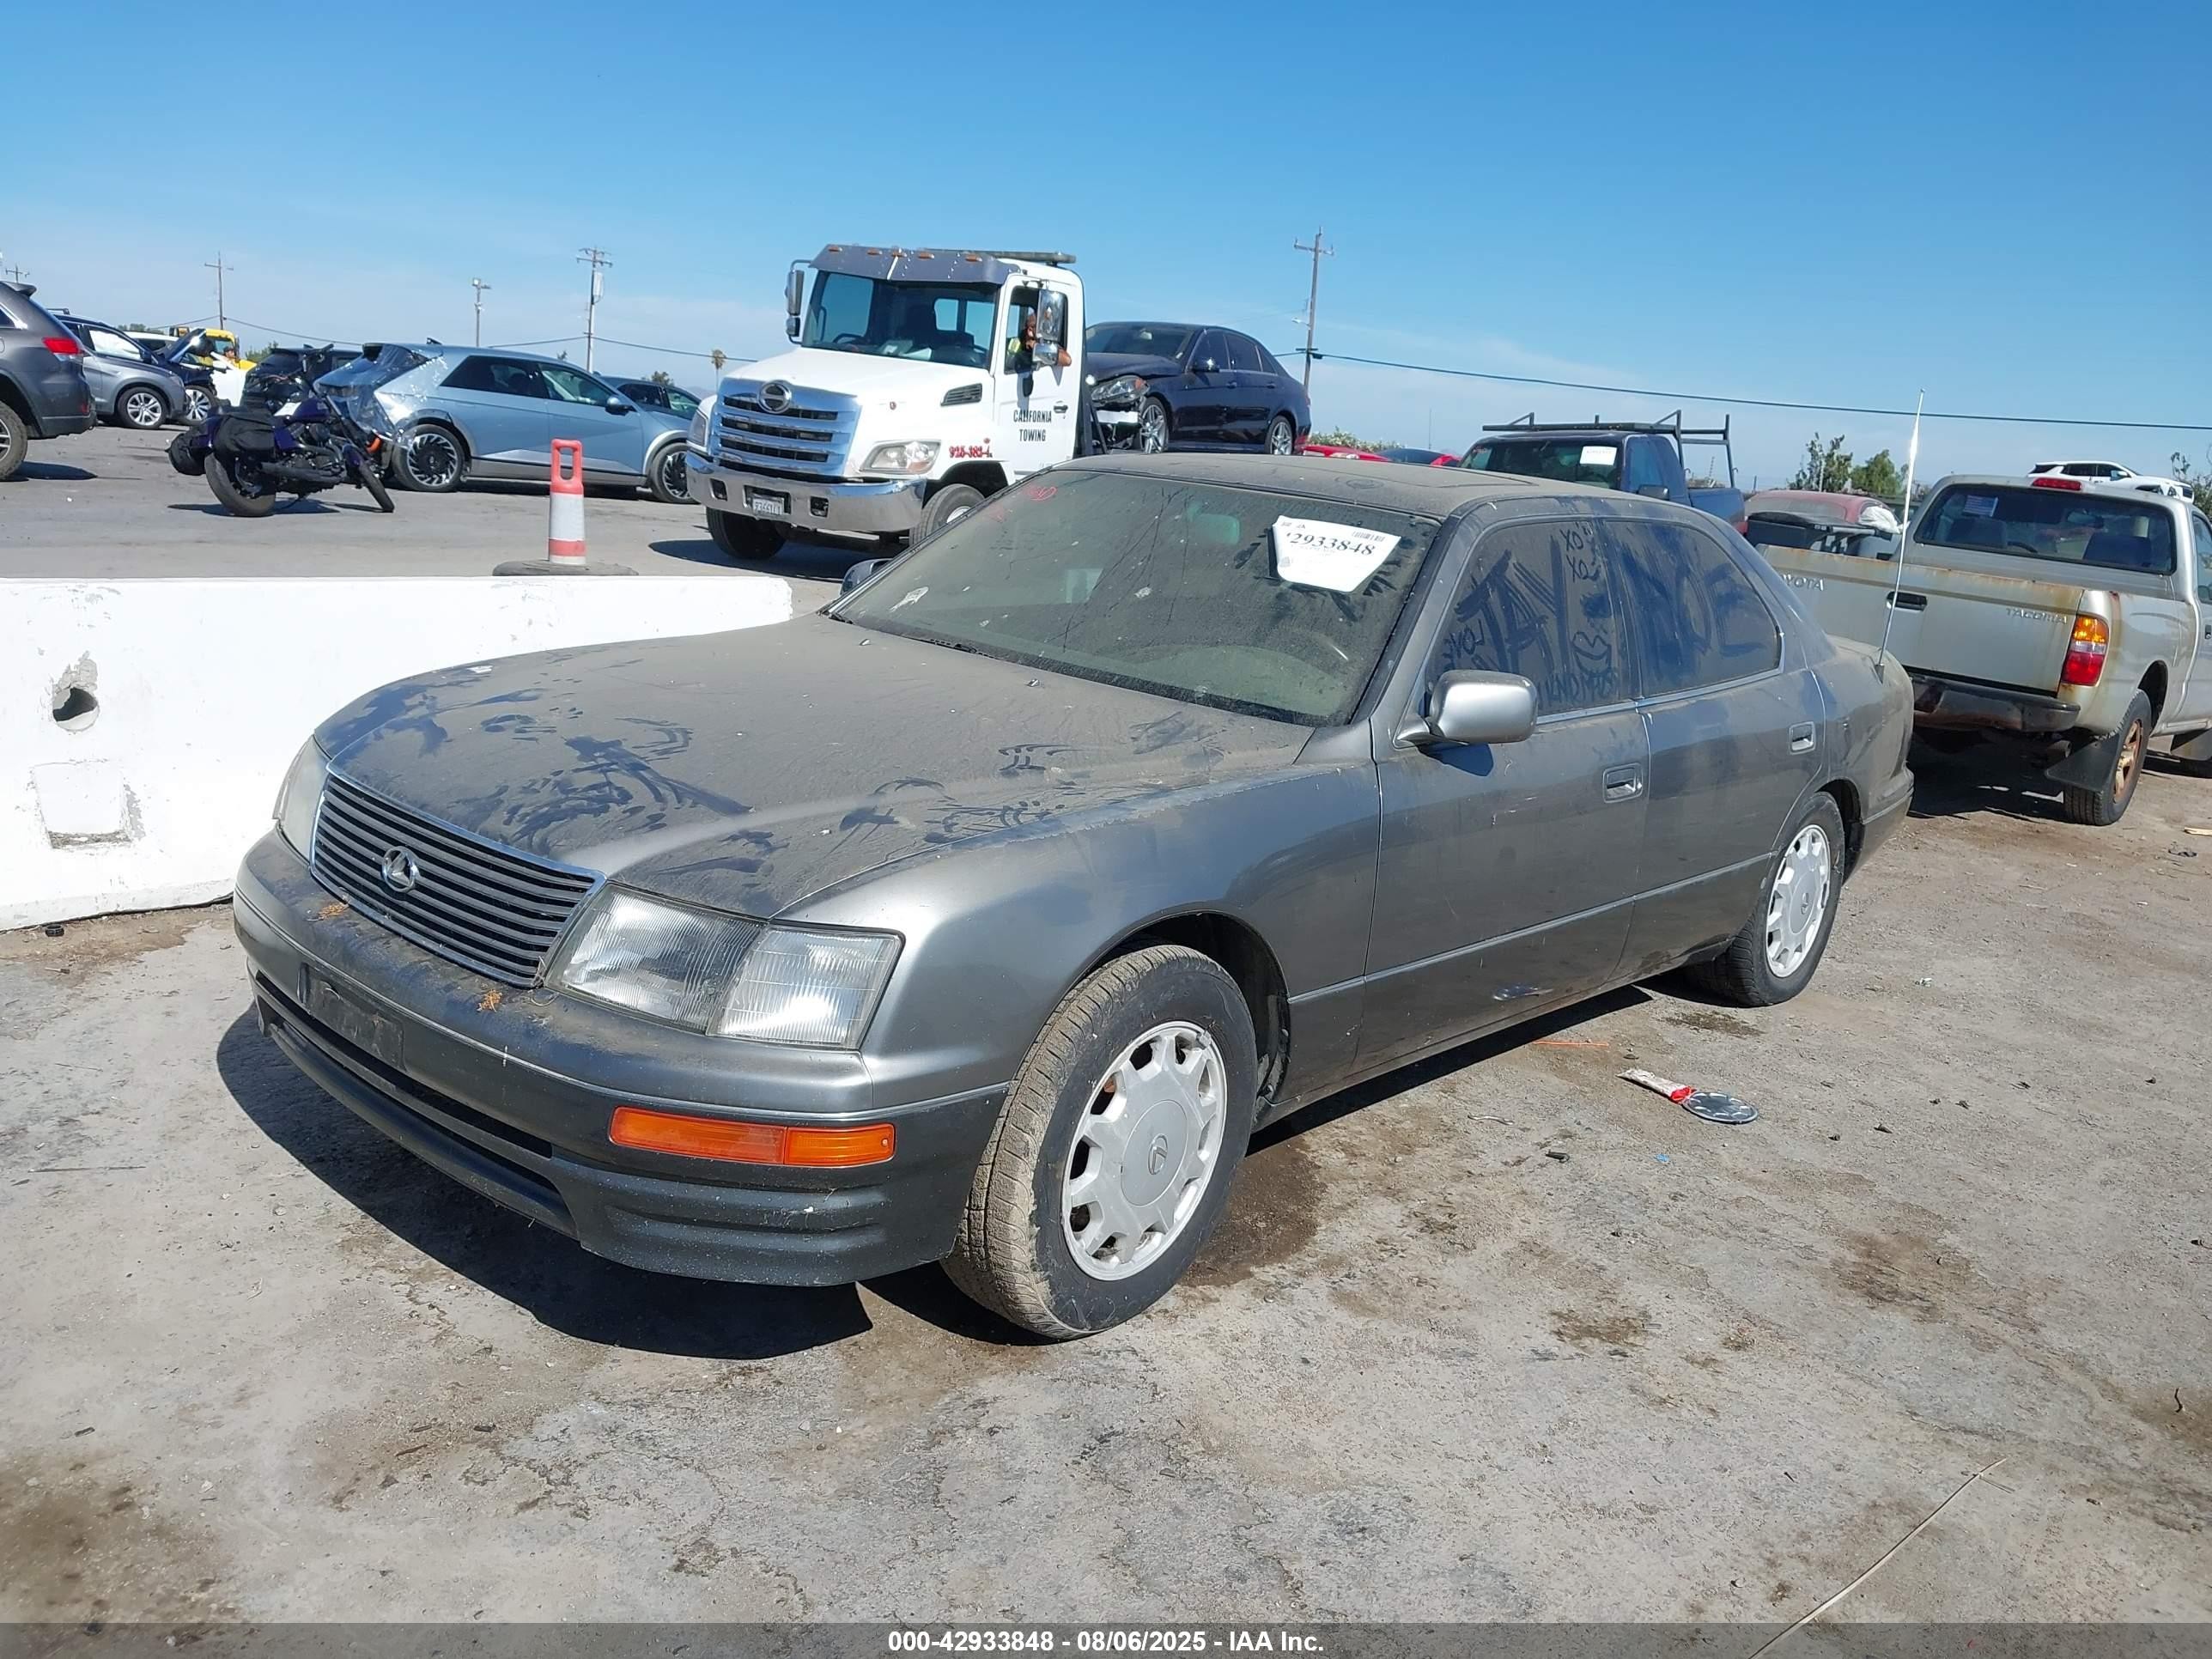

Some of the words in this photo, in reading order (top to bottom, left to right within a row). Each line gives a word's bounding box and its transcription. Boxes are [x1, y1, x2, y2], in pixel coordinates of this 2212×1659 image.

[1013, 410, 1052, 422] CALIFORNIA
[1019, 428, 1046, 441] TOWING
[1286, 532, 1376, 556] 2933848
[1780, 573, 1824, 592] YOTA
